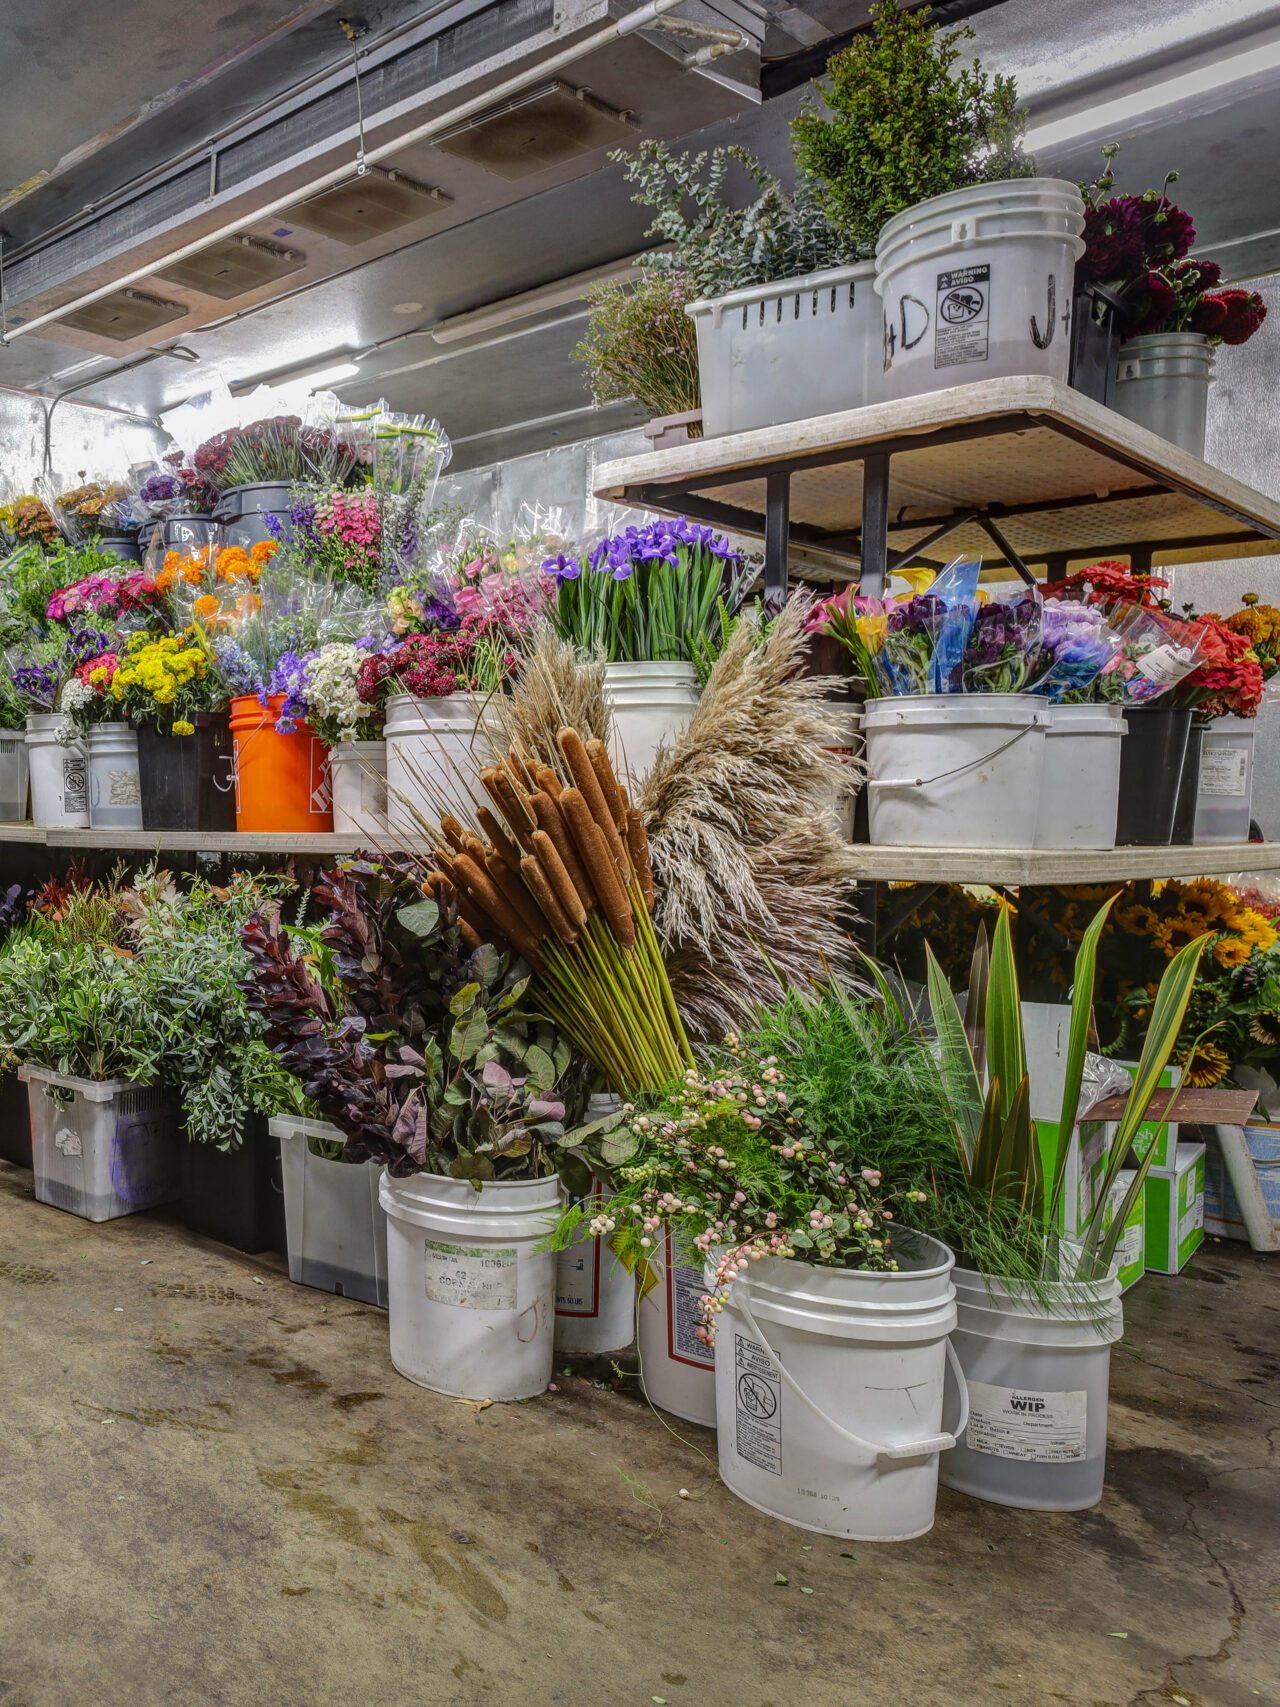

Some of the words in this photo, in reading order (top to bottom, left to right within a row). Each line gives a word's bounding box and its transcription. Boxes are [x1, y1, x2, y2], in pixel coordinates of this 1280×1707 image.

[951, 266, 988, 279] WARNING
[951, 276, 974, 287] AVISO
[1010, 1400, 1045, 1413] WIP
